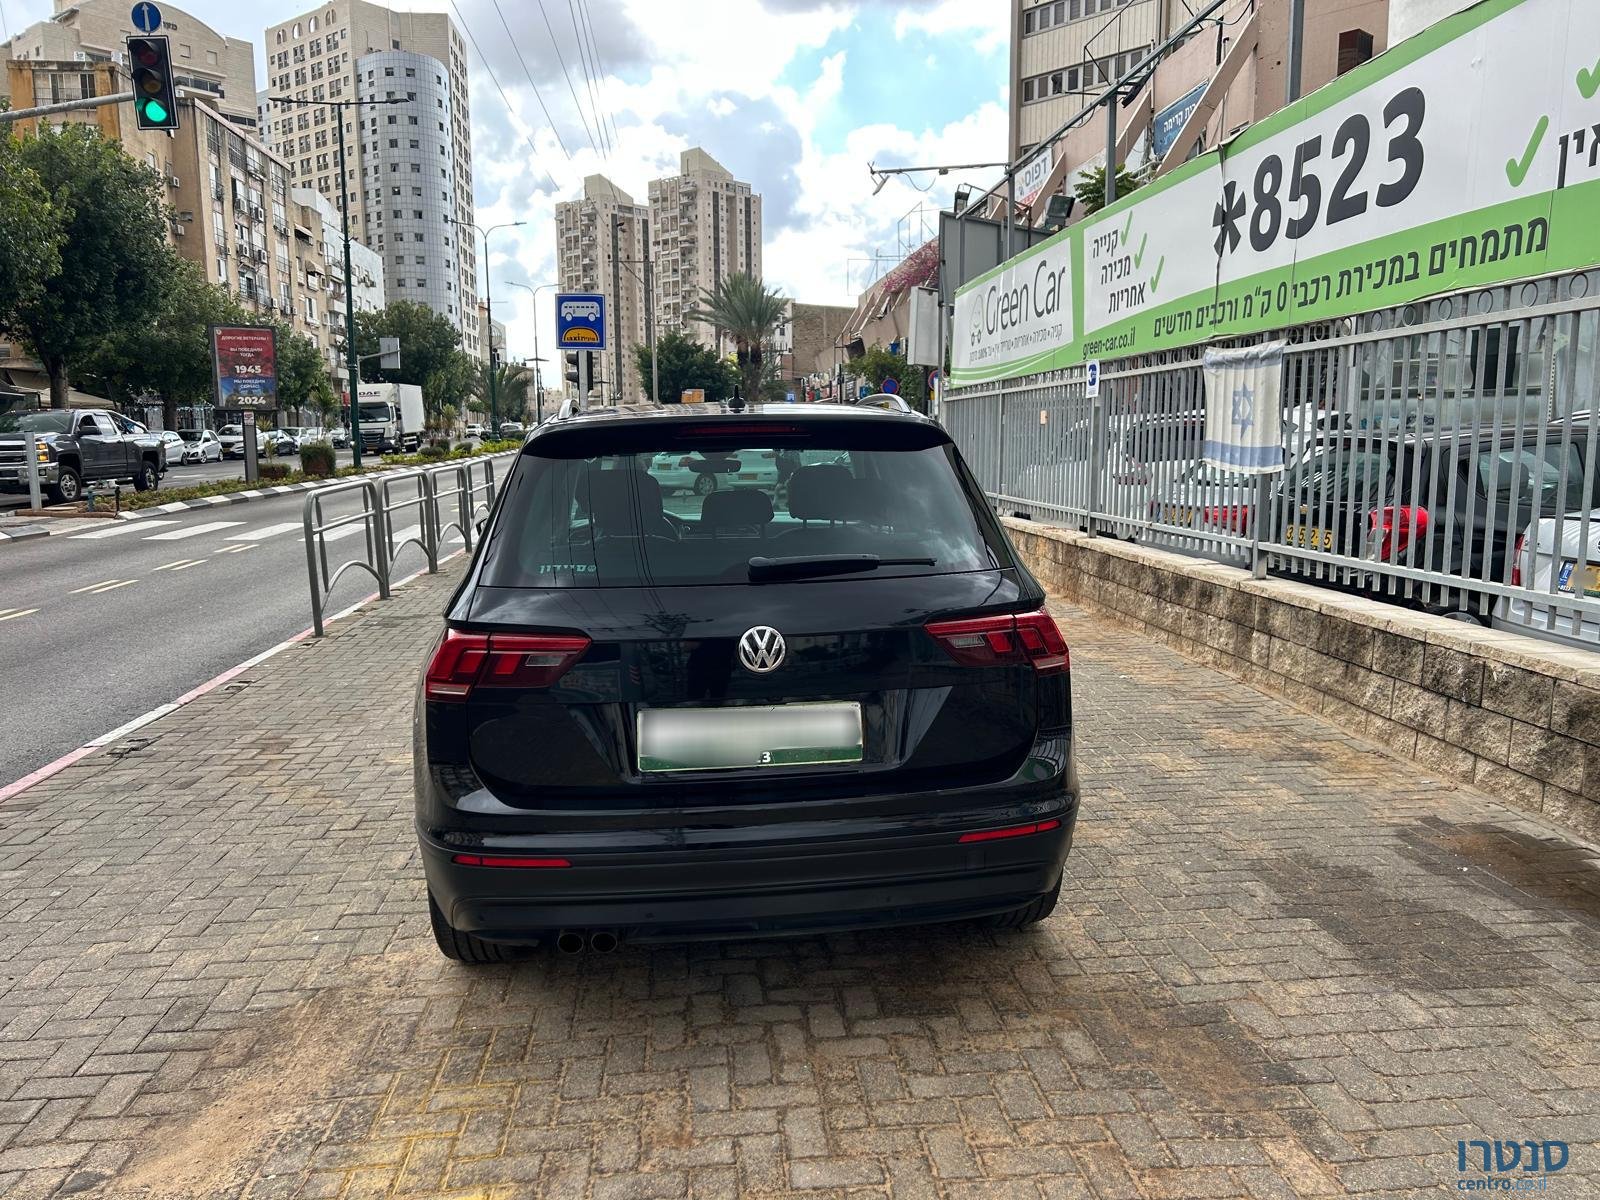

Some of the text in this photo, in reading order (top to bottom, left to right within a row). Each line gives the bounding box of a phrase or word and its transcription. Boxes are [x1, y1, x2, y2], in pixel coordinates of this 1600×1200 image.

[1025, 157, 1047, 187] דפוס
[1092, 229, 1118, 258] קנייה
[1429, 216, 1548, 276] מתמחים
[1101, 255, 1131, 285] מכירה
[1336, 252, 1419, 300] במכירת
[986, 260, 1066, 336] Green Car
[1108, 282, 1146, 314] אחריות
[1277, 281, 1287, 312] 0
[1293, 275, 1331, 308] רכבי
[1154, 310, 1192, 337] חדשים
[1196, 298, 1239, 329] ורכבים
[1082, 326, 1136, 360] green-car.co.il
[234, 365, 262, 374] 1945
[237, 396, 267, 405] 2024
